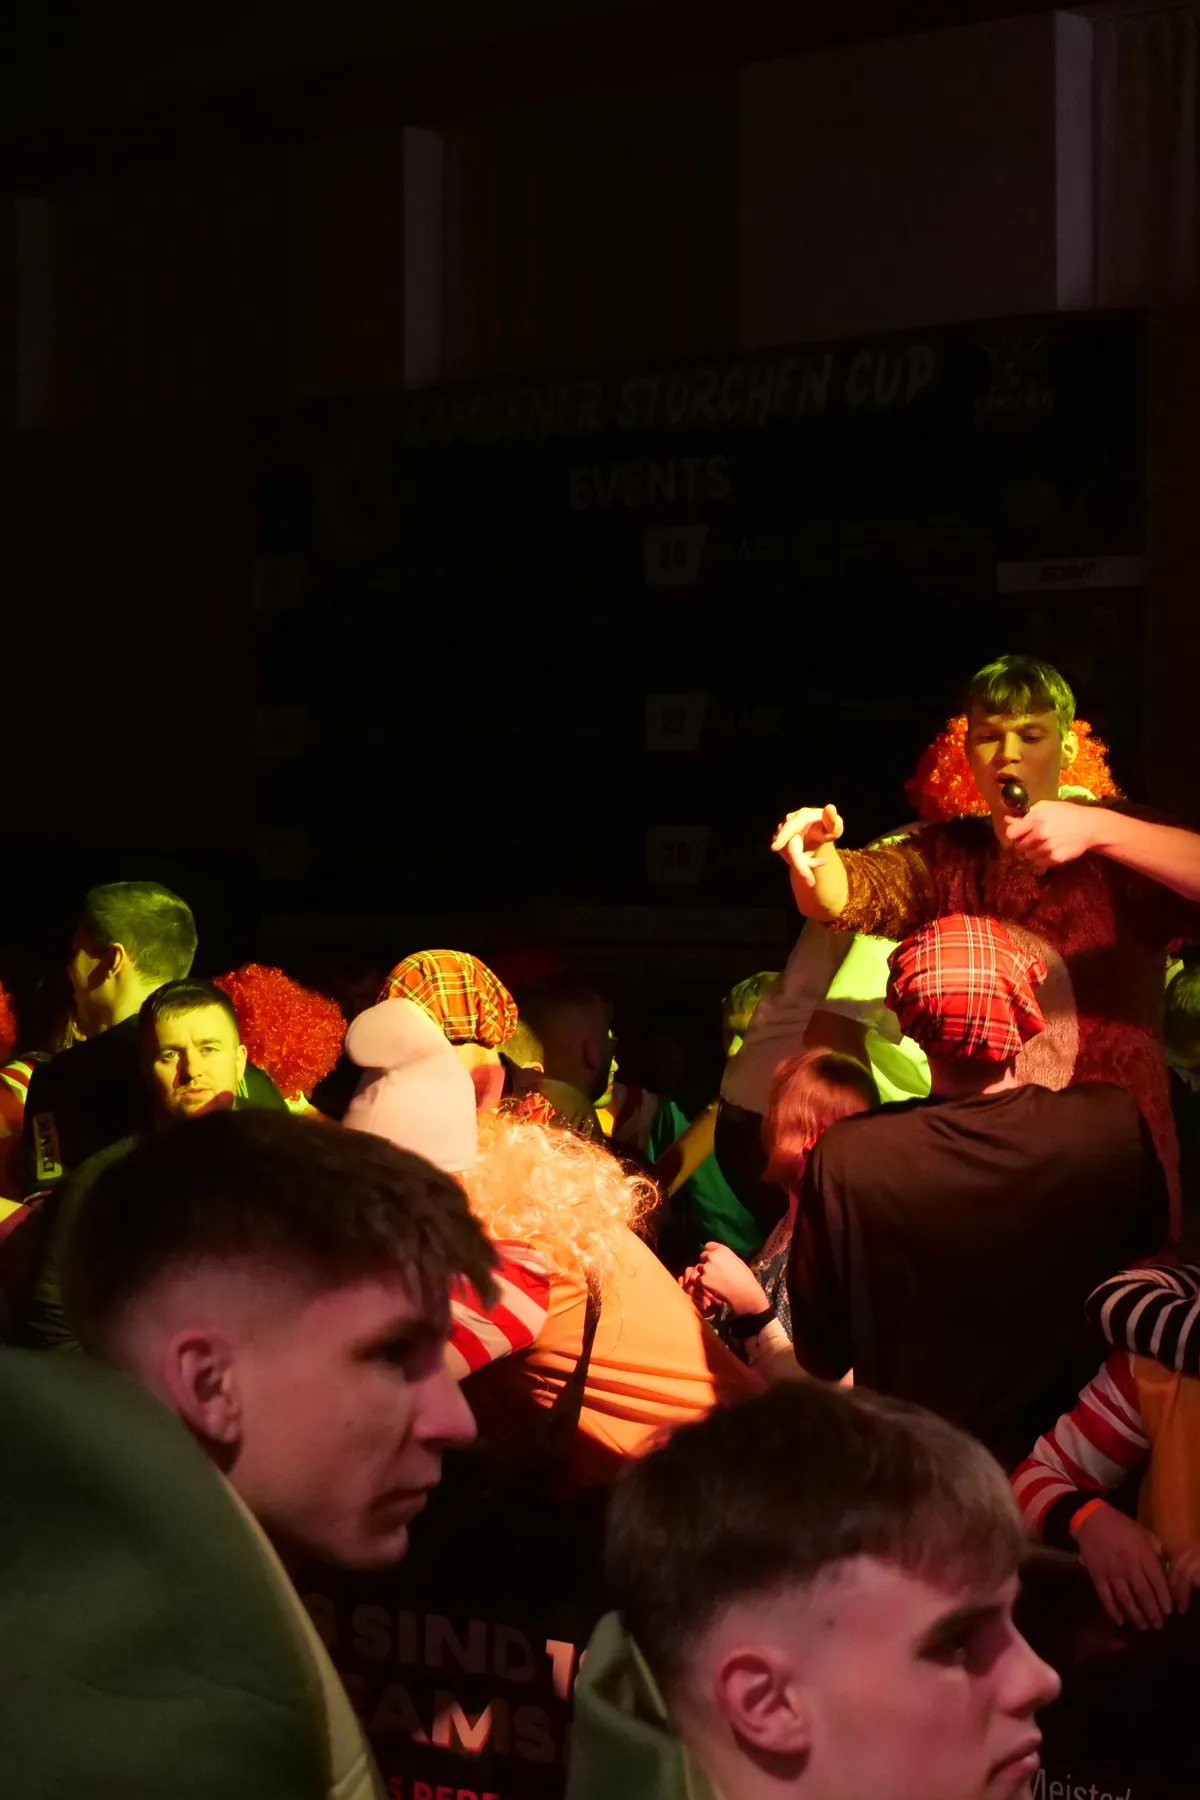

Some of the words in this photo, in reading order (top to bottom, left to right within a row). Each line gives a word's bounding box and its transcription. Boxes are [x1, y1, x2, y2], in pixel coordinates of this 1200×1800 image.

[846, 344, 937, 408] CUP
[568, 452, 732, 511] EVENTS
[351, 1603, 538, 1683] SIND
[545, 1636, 588, 1700] 1
[345, 1672, 556, 1764] AMS
